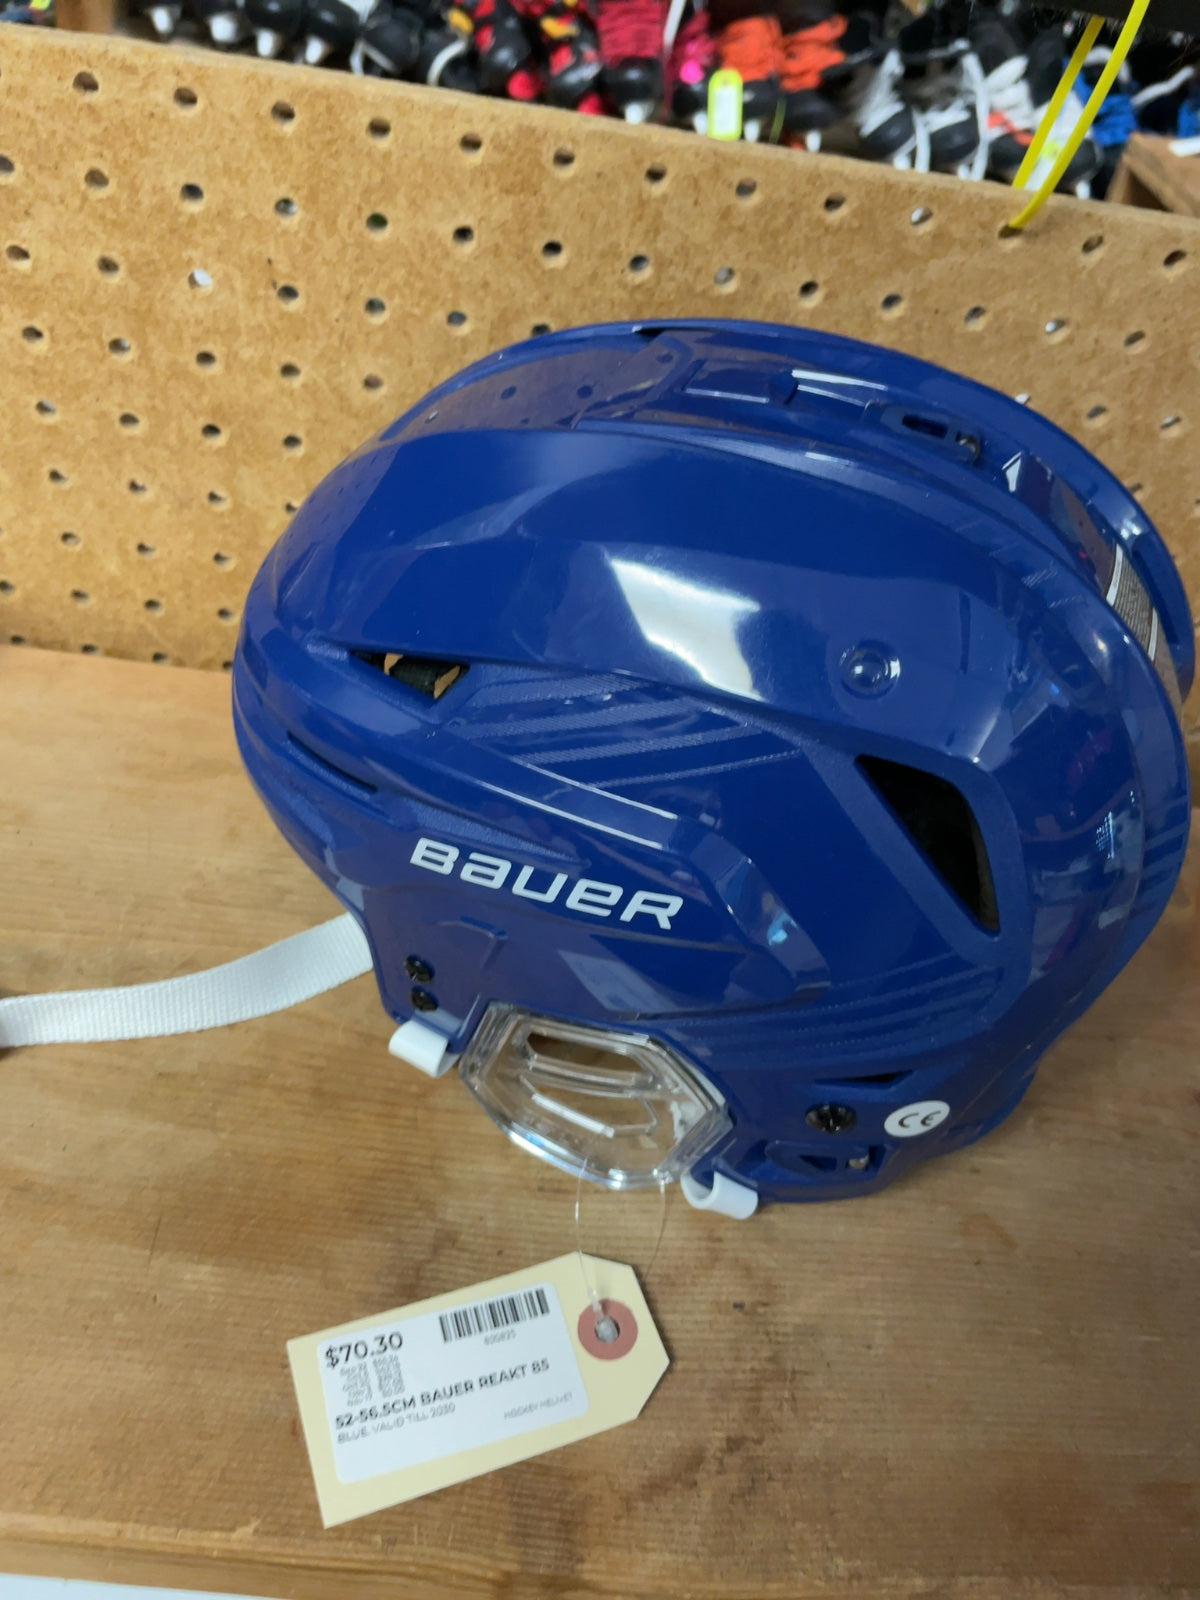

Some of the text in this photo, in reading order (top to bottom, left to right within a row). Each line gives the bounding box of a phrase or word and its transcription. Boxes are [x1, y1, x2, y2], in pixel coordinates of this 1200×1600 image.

[409, 837, 684, 930] BAUER
[325, 1331, 403, 1369] $70.30
[336, 1395, 416, 1429] 52-56.5CM
[420, 1380, 474, 1406] BAUER
[479, 1364, 527, 1389] REAKT
[531, 1358, 550, 1374] 85
[372, 1416, 405, 1433] VALID
[407, 1410, 428, 1424] TILL
[430, 1402, 456, 1418] 2030
